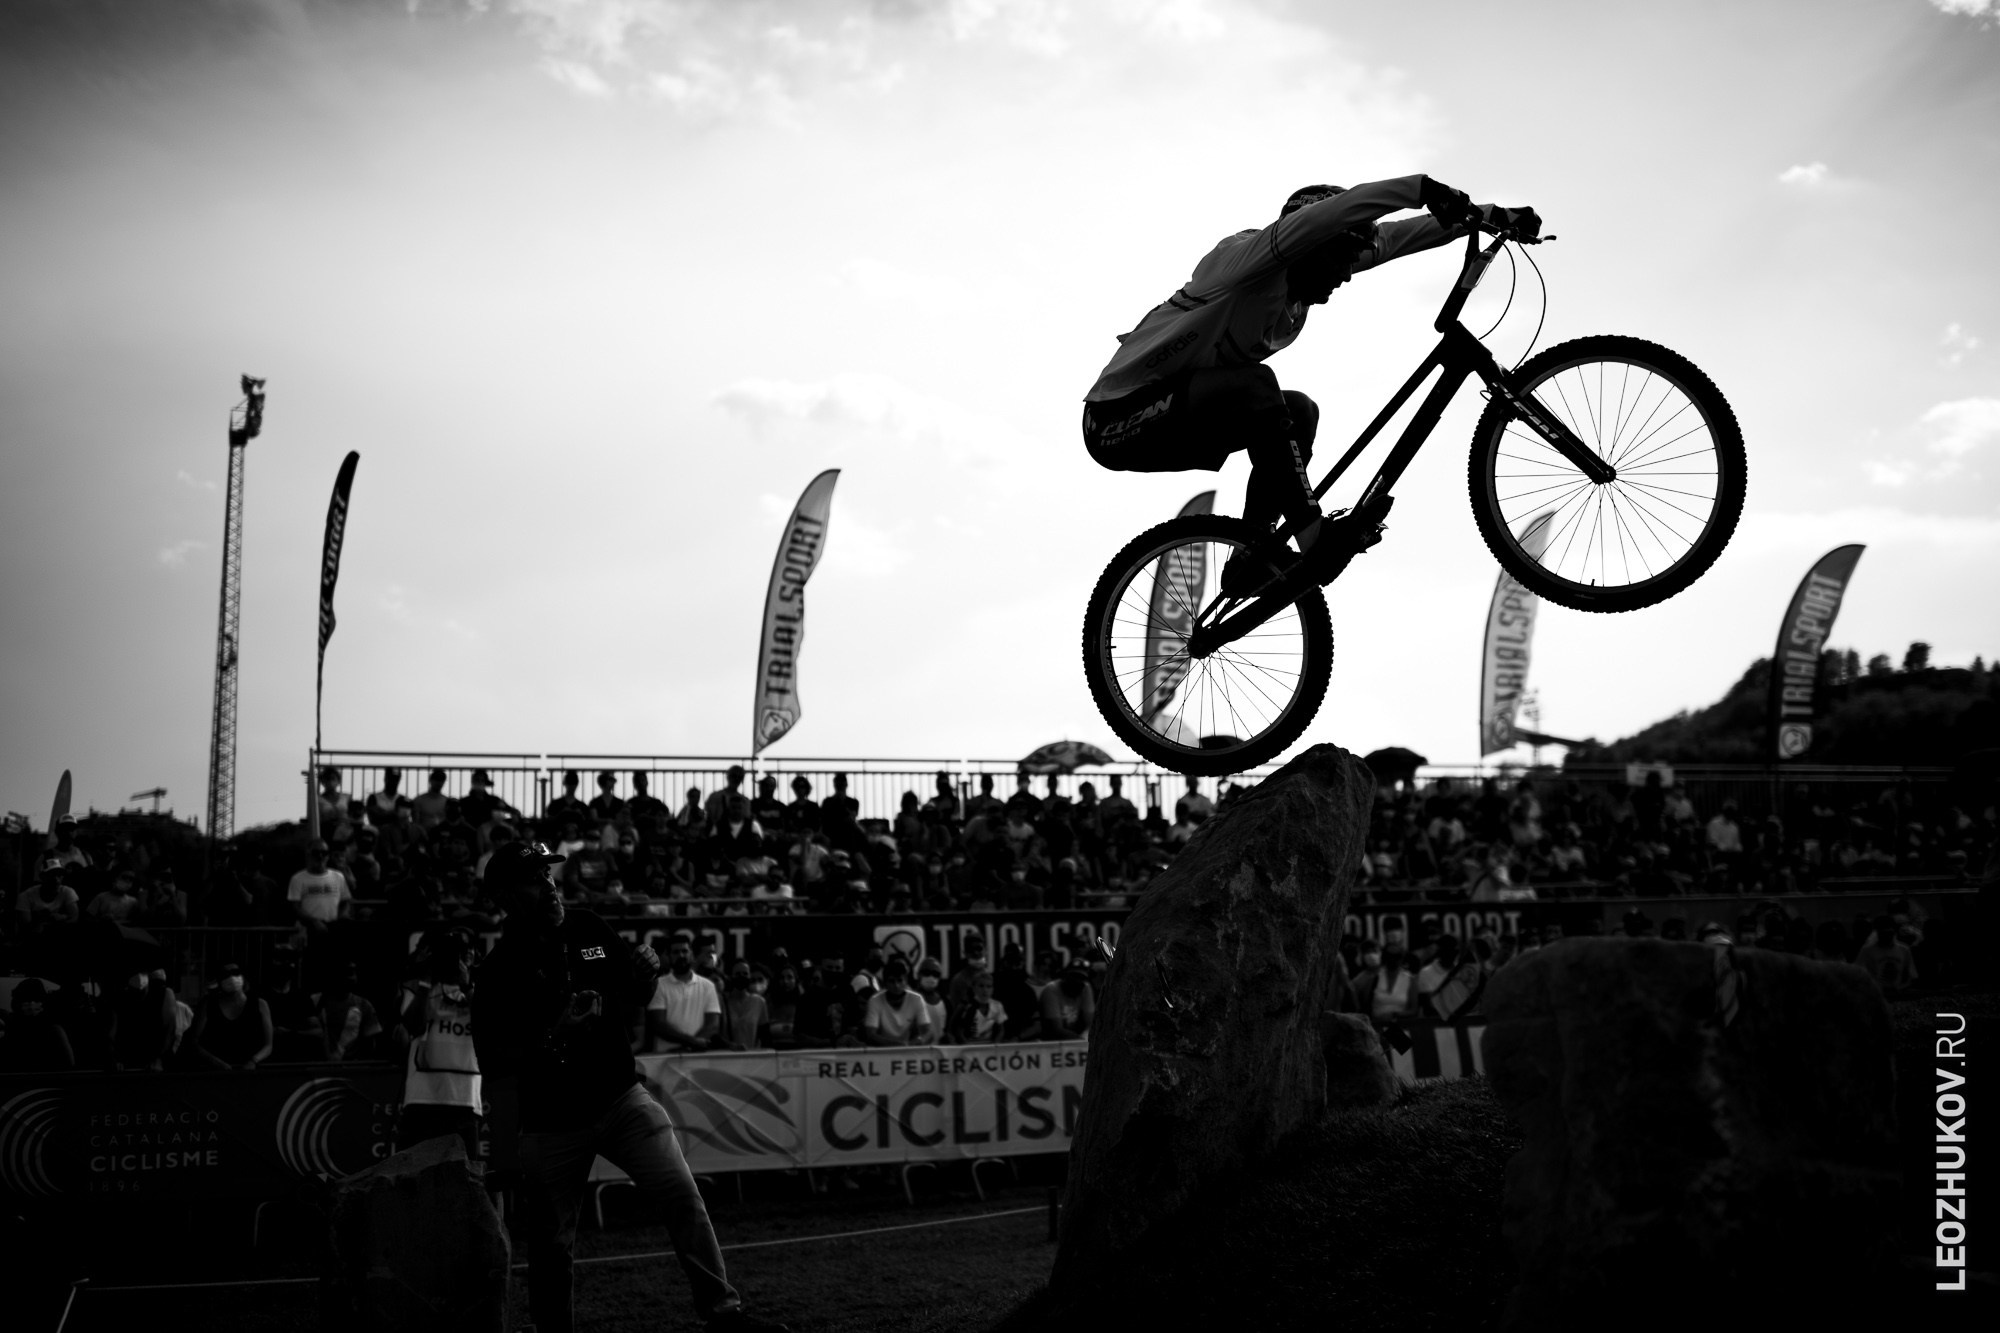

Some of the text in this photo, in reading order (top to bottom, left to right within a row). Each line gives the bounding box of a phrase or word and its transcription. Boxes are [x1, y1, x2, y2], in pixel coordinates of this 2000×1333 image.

[1145, 330, 1199, 369] cofidis
[818, 1061, 881, 1079] REAL
[889, 1051, 1041, 1077] FEDERACIÓN
[89, 1130, 219, 1148] CATALANA
[89, 1149, 219, 1173] CICLISME
[89, 1179, 141, 1192] 1896
